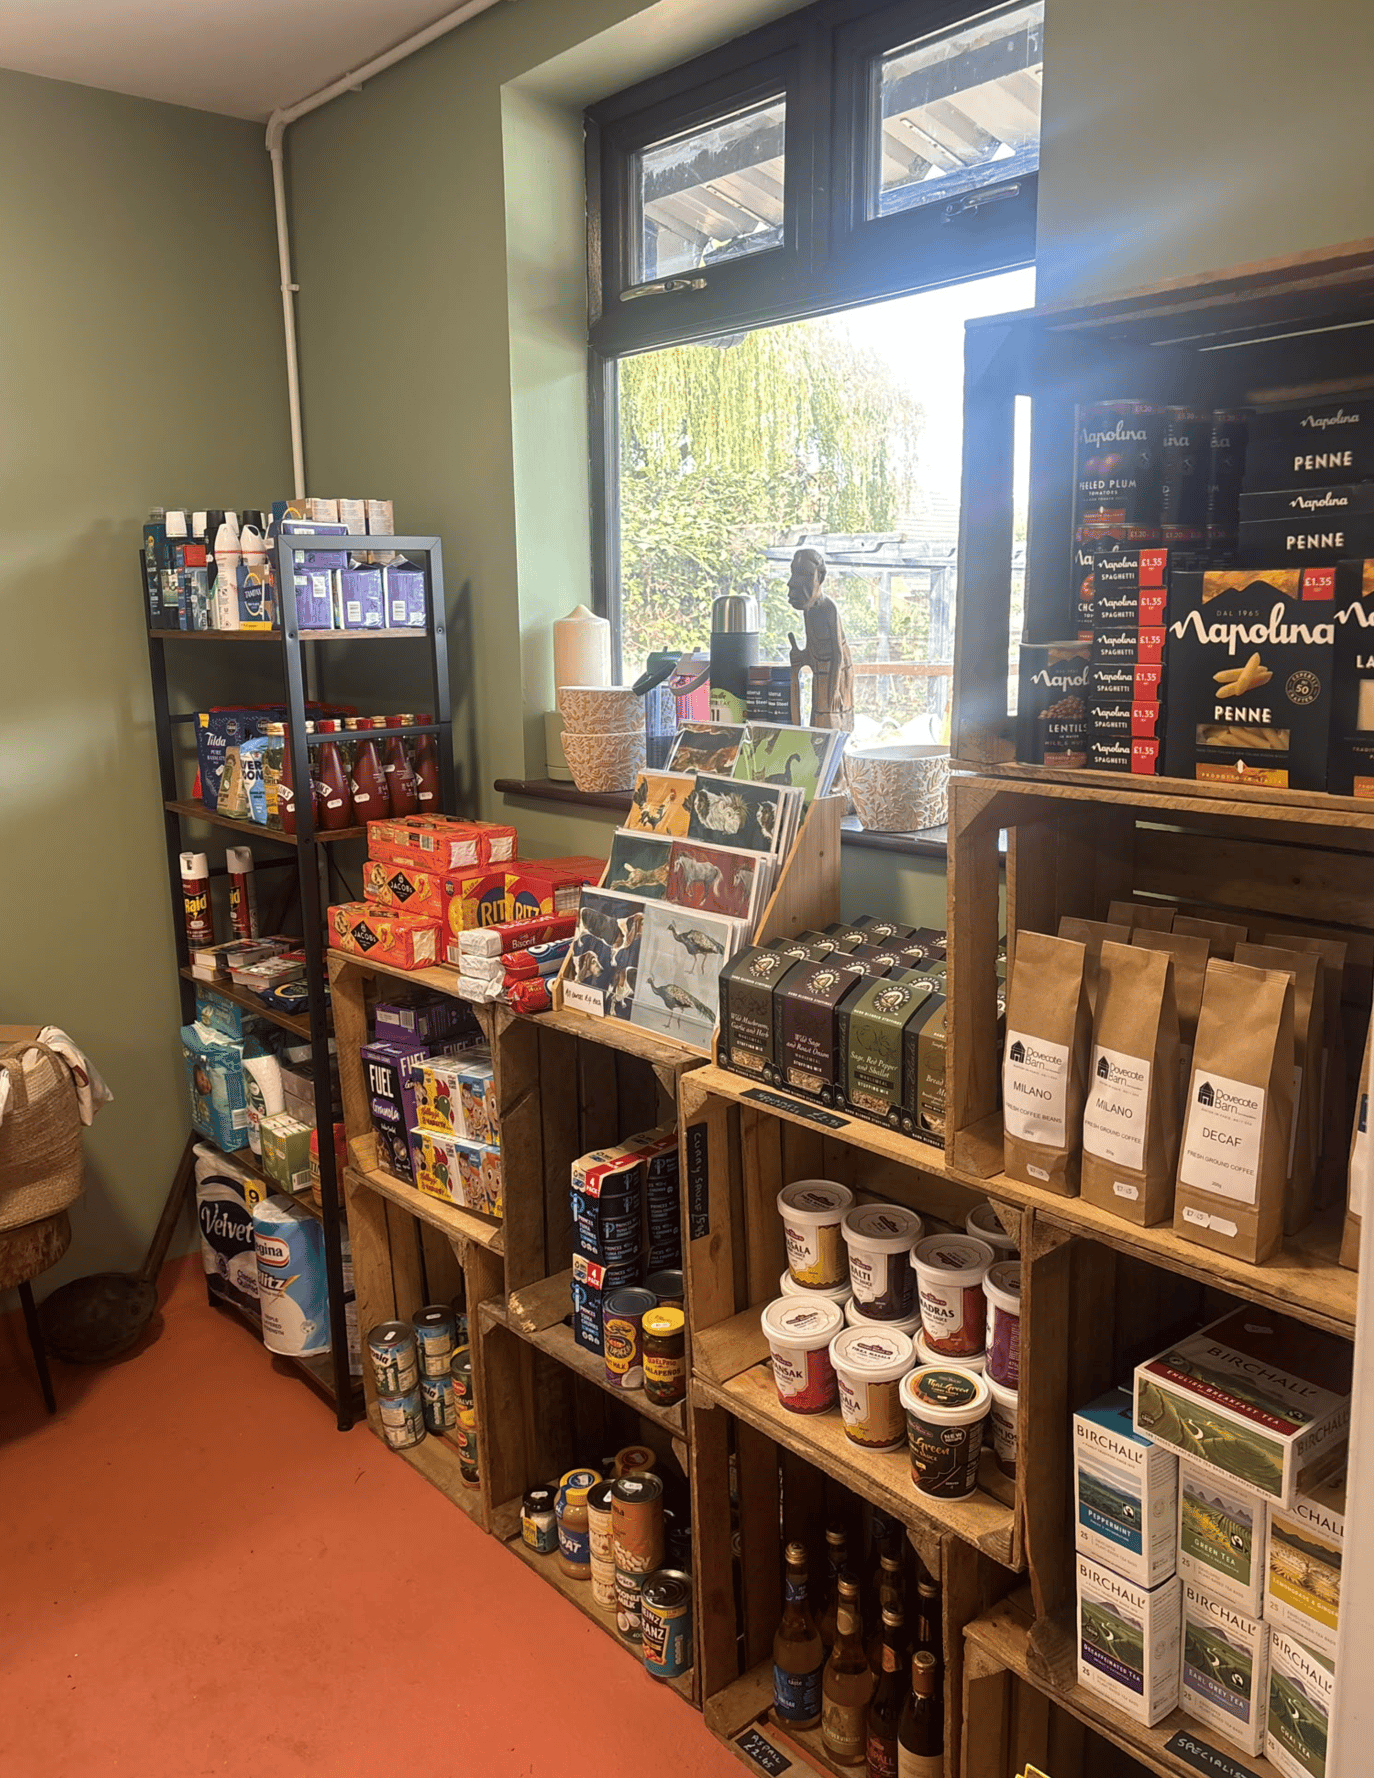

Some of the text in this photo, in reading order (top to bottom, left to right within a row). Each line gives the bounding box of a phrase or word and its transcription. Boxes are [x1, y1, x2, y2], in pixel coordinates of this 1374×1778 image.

[1300, 409, 1360, 430] Napolina
[1294, 451, 1353, 471] PENNE
[1109, 479, 1137, 489] PLUM
[1288, 491, 1348, 512] Napolina
[1286, 532, 1345, 551] PENNE
[1097, 556, 1138, 571] Napolina
[1140, 557, 1162, 567] £1.35
[1101, 572, 1135, 581] SPAGHETTI
[1304, 577, 1332, 587] £1.35
[1097, 594, 1138, 610] Napolina
[1140, 597, 1162, 606] £1.35
[1101, 611, 1135, 619] SPAGHETTI
[1169, 602, 1335, 656] Napolina
[1097, 633, 1137, 648] Napolina
[1140, 635, 1161, 645] £1.35
[1101, 648, 1134, 656] SPAGHETTI
[1093, 669, 1133, 684] Napolina
[1136, 672, 1157, 682] £1.35
[1097, 684, 1130, 693] SPAGHETTI
[1091, 706, 1131, 721] Napolina
[1133, 709, 1154, 719] £1.35
[1214, 706, 1272, 724] PENNE
[1095, 720, 1128, 729] SPAGHETTI
[205, 732, 227, 747] Tilda
[1091, 742, 1131, 757] Napolina
[1133, 746, 1154, 756] £1.35
[1095, 756, 1128, 765] SPAGHETTI
[184, 894, 207, 914] Raid
[878, 985, 911, 1004] SHROPSHIRE
[874, 999, 887, 1013] SPICE
[786, 1041, 797, 1049] and
[812, 1047, 830, 1059] Onion
[1026, 1046, 1063, 1067] Dovecote
[850, 1050, 898, 1072] Sage, Red Pepper
[1024, 1056, 1045, 1070] Barn
[857, 1064, 890, 1079] and Shallot
[1110, 1062, 1144, 1082] Dovecote
[369, 1064, 394, 1098] FUEL
[858, 1081, 879, 1093] STUFFING
[926, 1074, 944, 1087] Bread
[1108, 1072, 1127, 1087] Barn
[1013, 1080, 1052, 1101] MILANO
[1214, 1099, 1238, 1114] Barn
[1215, 1088, 1258, 1110] Dovecote
[1096, 1097, 1133, 1119] MILANO
[1020, 1108, 1041, 1119] COFFEE
[1041, 1114, 1063, 1124] BEANS
[1085, 1119, 1142, 1145] FRESH GROUND COFFEE
[1202, 1127, 1243, 1147] DECAF
[1187, 1149, 1255, 1176] FRESH GROUND COFFEE
[586, 1184, 599, 1195] PACK
[589, 1177, 596, 1187] 4
[248, 1189, 260, 1204] 9
[694, 1177, 703, 1212] SAUCE
[201, 1203, 254, 1243] Velvet
[591, 1269, 597, 1279] 4
[1207, 1346, 1311, 1398] BIRCHALL
[1167, 1370, 1280, 1425] ENGLISH BREAKFAST TEA
[944, 1432, 963, 1440] NEW
[1077, 1424, 1142, 1464] BIRCHALL
[1088, 1508, 1131, 1537] PEPPERMINT
[1080, 1530, 1088, 1540] 25
[1194, 1538, 1218, 1556] GREEN
[1220, 1551, 1236, 1566] TEA
[1181, 1557, 1190, 1568] 25
[1080, 1563, 1143, 1610] BIRCHALL
[1186, 1587, 1253, 1637] BIRCHALL
[1269, 1602, 1279, 1612] 25
[1084, 1643, 1141, 1682] DECAFFEINATED TEA
[1272, 1633, 1329, 1694] BIRCHALL
[1082, 1666, 1090, 1677] 25
[1183, 1691, 1192, 1701] 25
[1188, 1668, 1245, 1709] EARL GREY TEA
[751, 1734, 781, 1764] ASPALL
[1267, 1738, 1275, 1751] 25
[1280, 1725, 1311, 1759] CHAI TEA
[743, 1744, 775, 1769] £2.45
